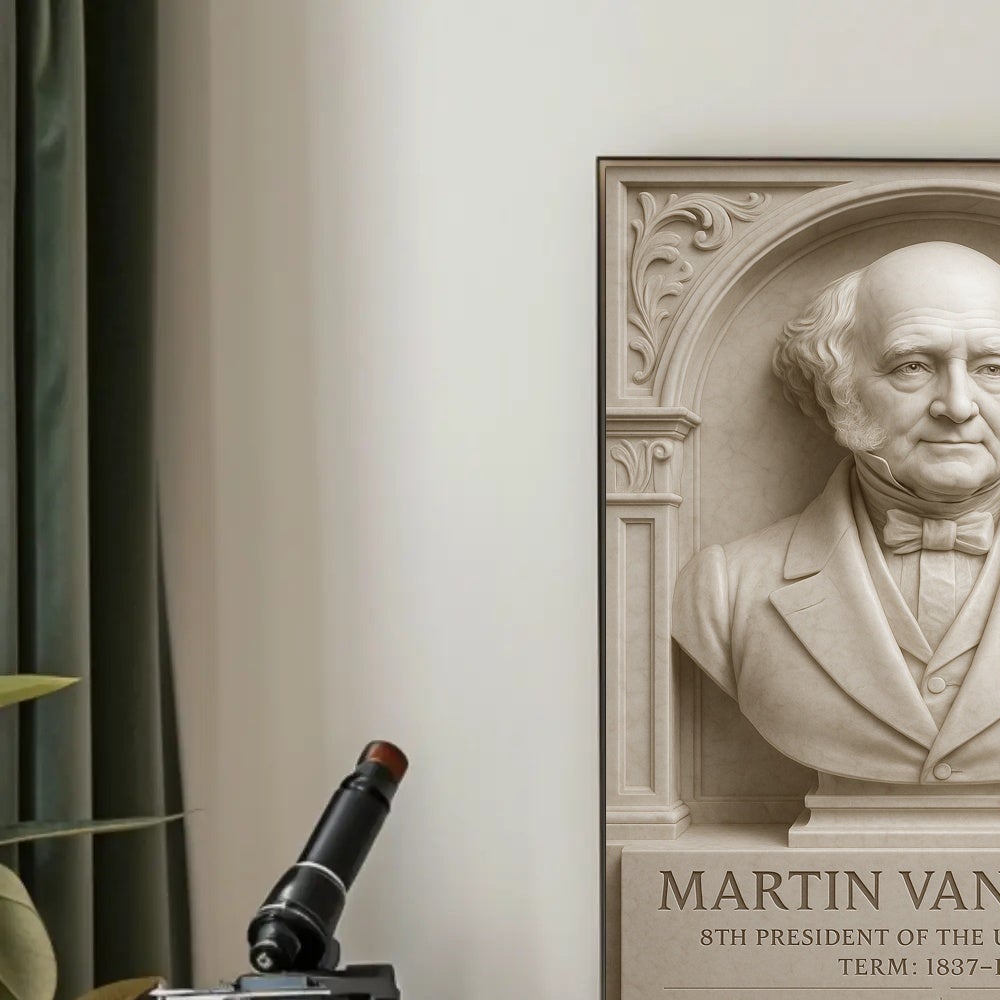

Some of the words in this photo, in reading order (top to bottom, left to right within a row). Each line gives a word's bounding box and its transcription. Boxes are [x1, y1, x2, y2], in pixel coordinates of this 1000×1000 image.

[657, 870, 883, 911] MARTIN
[700, 928, 747, 946] 8TH
[755, 928, 890, 946] PRESIDENT
[896, 928, 929, 946] OF
[935, 928, 984, 946] THE
[837, 957, 917, 976] TERM:
